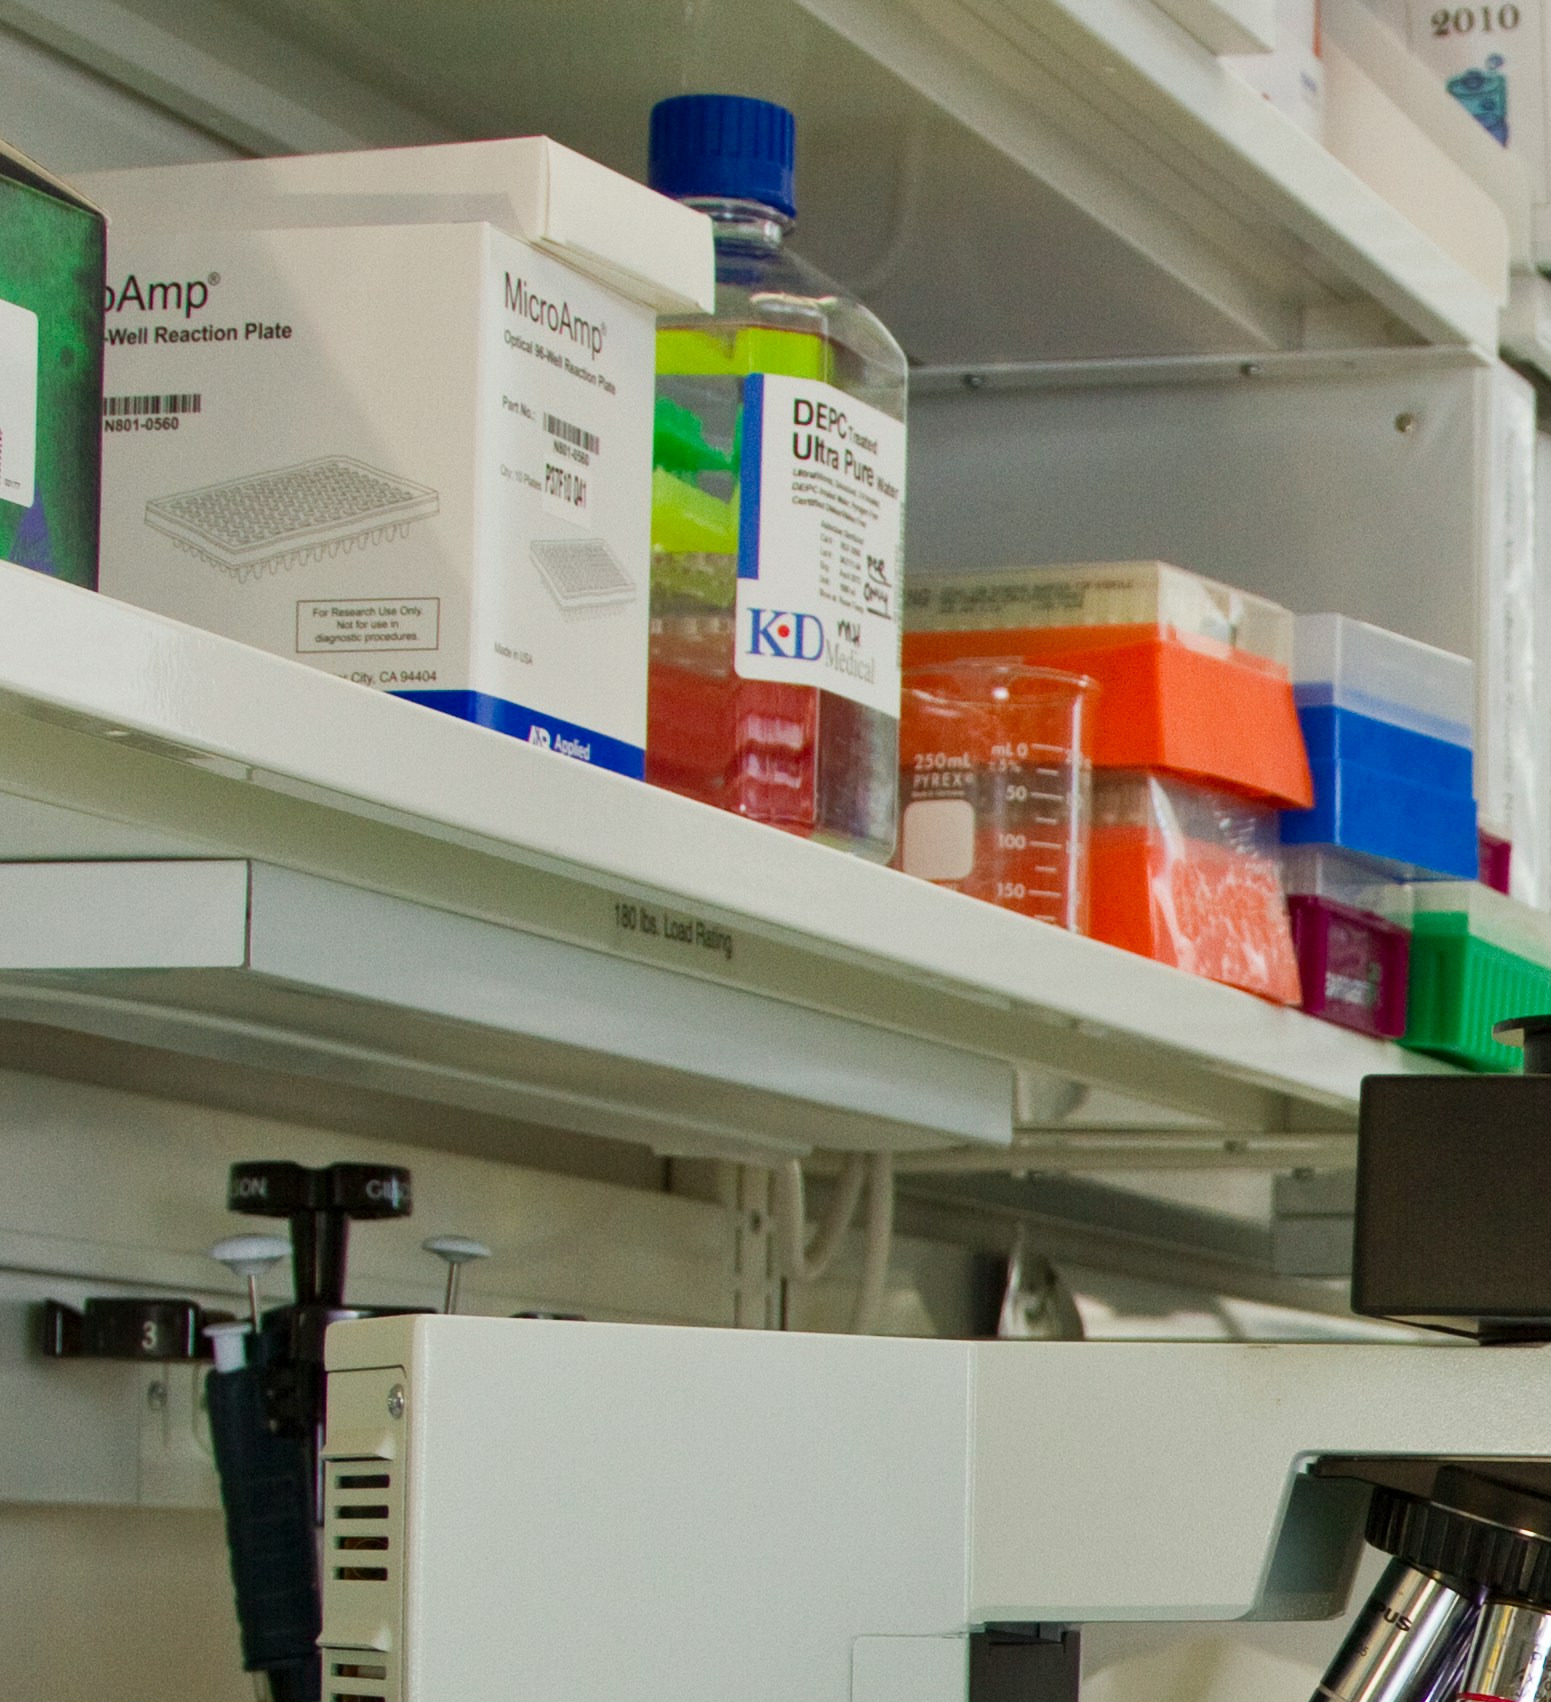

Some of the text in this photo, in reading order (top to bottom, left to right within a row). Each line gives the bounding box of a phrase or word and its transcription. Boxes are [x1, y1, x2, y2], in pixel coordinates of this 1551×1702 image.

[1430, 3, 1520, 37] 2010
[154, 324, 238, 344] Reaction
[244, 321, 293, 341] Plate
[504, 329, 533, 355] Optical
[564, 357, 597, 386] Reaction
[104, 416, 179, 433] N801-0560
[793, 397, 848, 440] DEPC
[792, 431, 840, 471] Ultra
[844, 448, 874, 488] Pure
[312, 607, 329, 618] For
[331, 606, 376, 617] Research
[378, 605, 397, 617] Use
[336, 619, 399, 629] Not for use in
[315, 632, 361, 645] diagnostic
[825, 638, 876, 685] Medical
[379, 670, 398, 683] CA
[400, 670, 437, 682] 94404
[553, 733, 591, 761] Applied
[1016, 742, 1029, 758] 0
[913, 751, 972, 771] 250mL
[1005, 785, 1028, 802] 50
[997, 832, 1027, 850] 100
[996, 882, 1027, 899] 150
[663, 912, 693, 944] Load
[141, 1320, 158, 1351] 3
